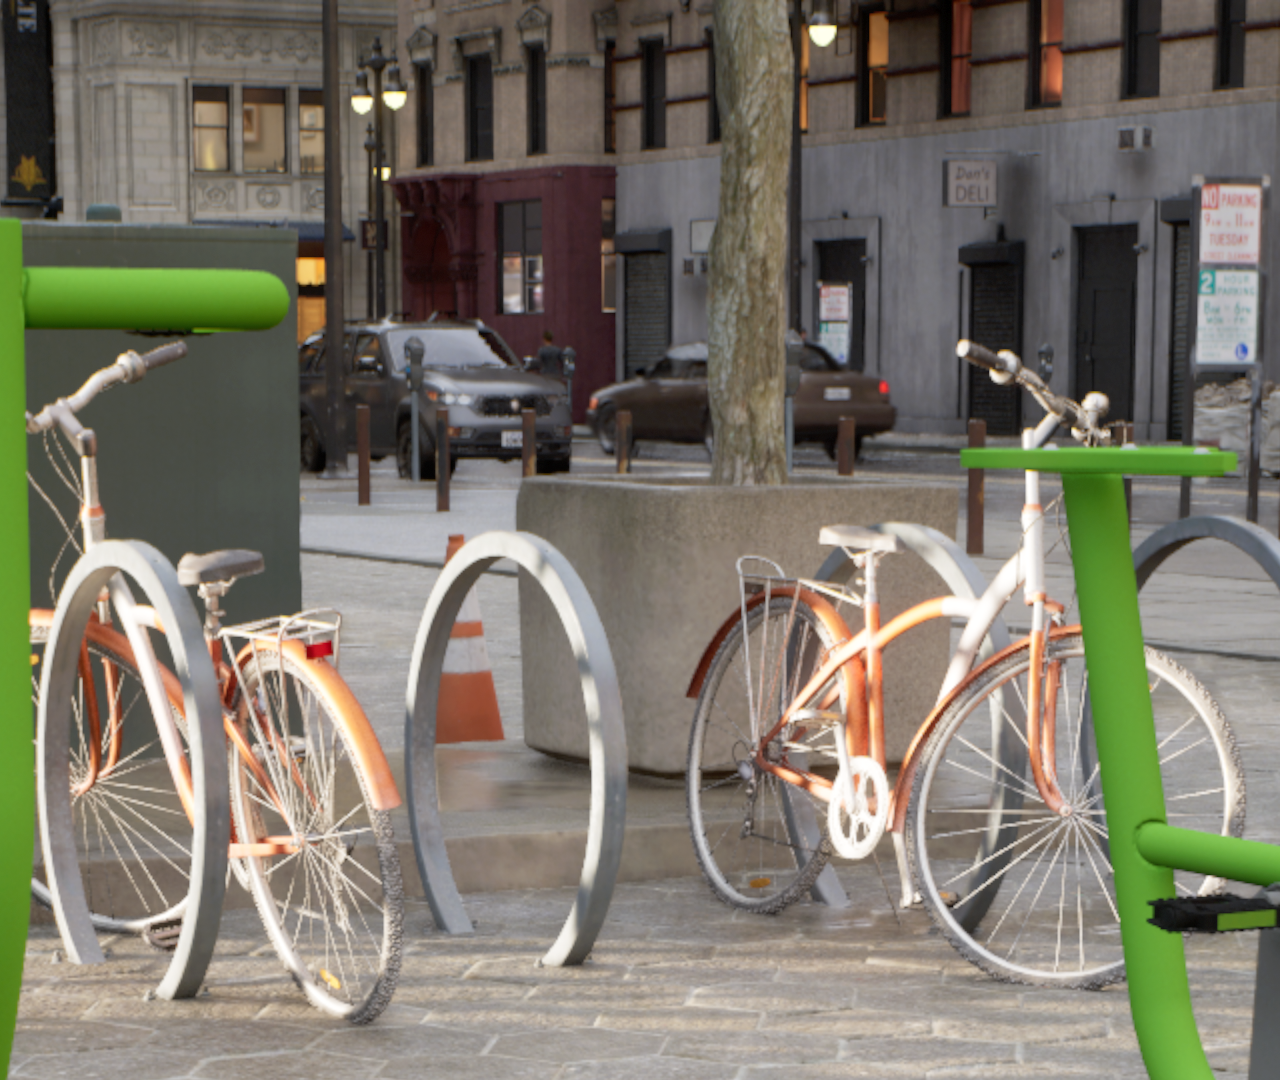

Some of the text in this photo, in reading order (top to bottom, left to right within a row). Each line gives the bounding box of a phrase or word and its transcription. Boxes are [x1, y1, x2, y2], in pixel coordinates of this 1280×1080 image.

[956, 184, 989, 202] DELI
[1202, 187, 1257, 209] NO PARKING
[1209, 233, 1249, 247] TUESDAY
[1201, 272, 1250, 294] 2 HOUR
[1218, 287, 1255, 296] PARKING
